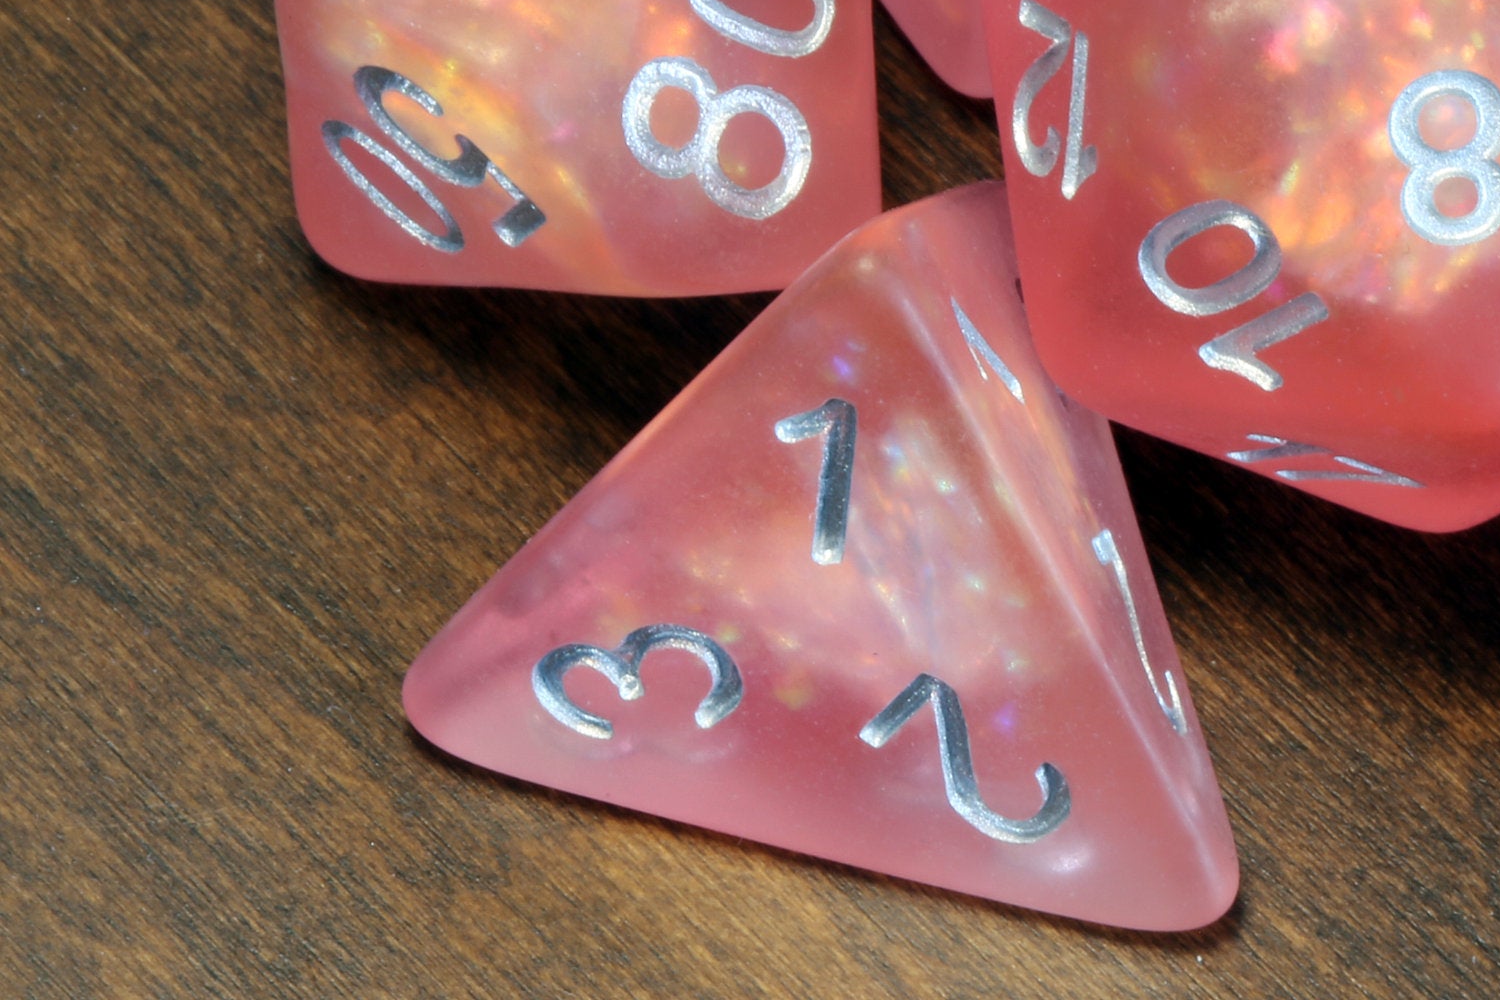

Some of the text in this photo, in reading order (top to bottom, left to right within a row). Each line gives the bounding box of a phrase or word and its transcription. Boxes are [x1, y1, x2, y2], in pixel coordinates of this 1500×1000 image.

[321, 65, 548, 253] 50
[1138, 201, 1329, 391] 10
[775, 398, 857, 565] 1
[533, 623, 743, 739] 3
[860, 673, 1072, 845] 2
